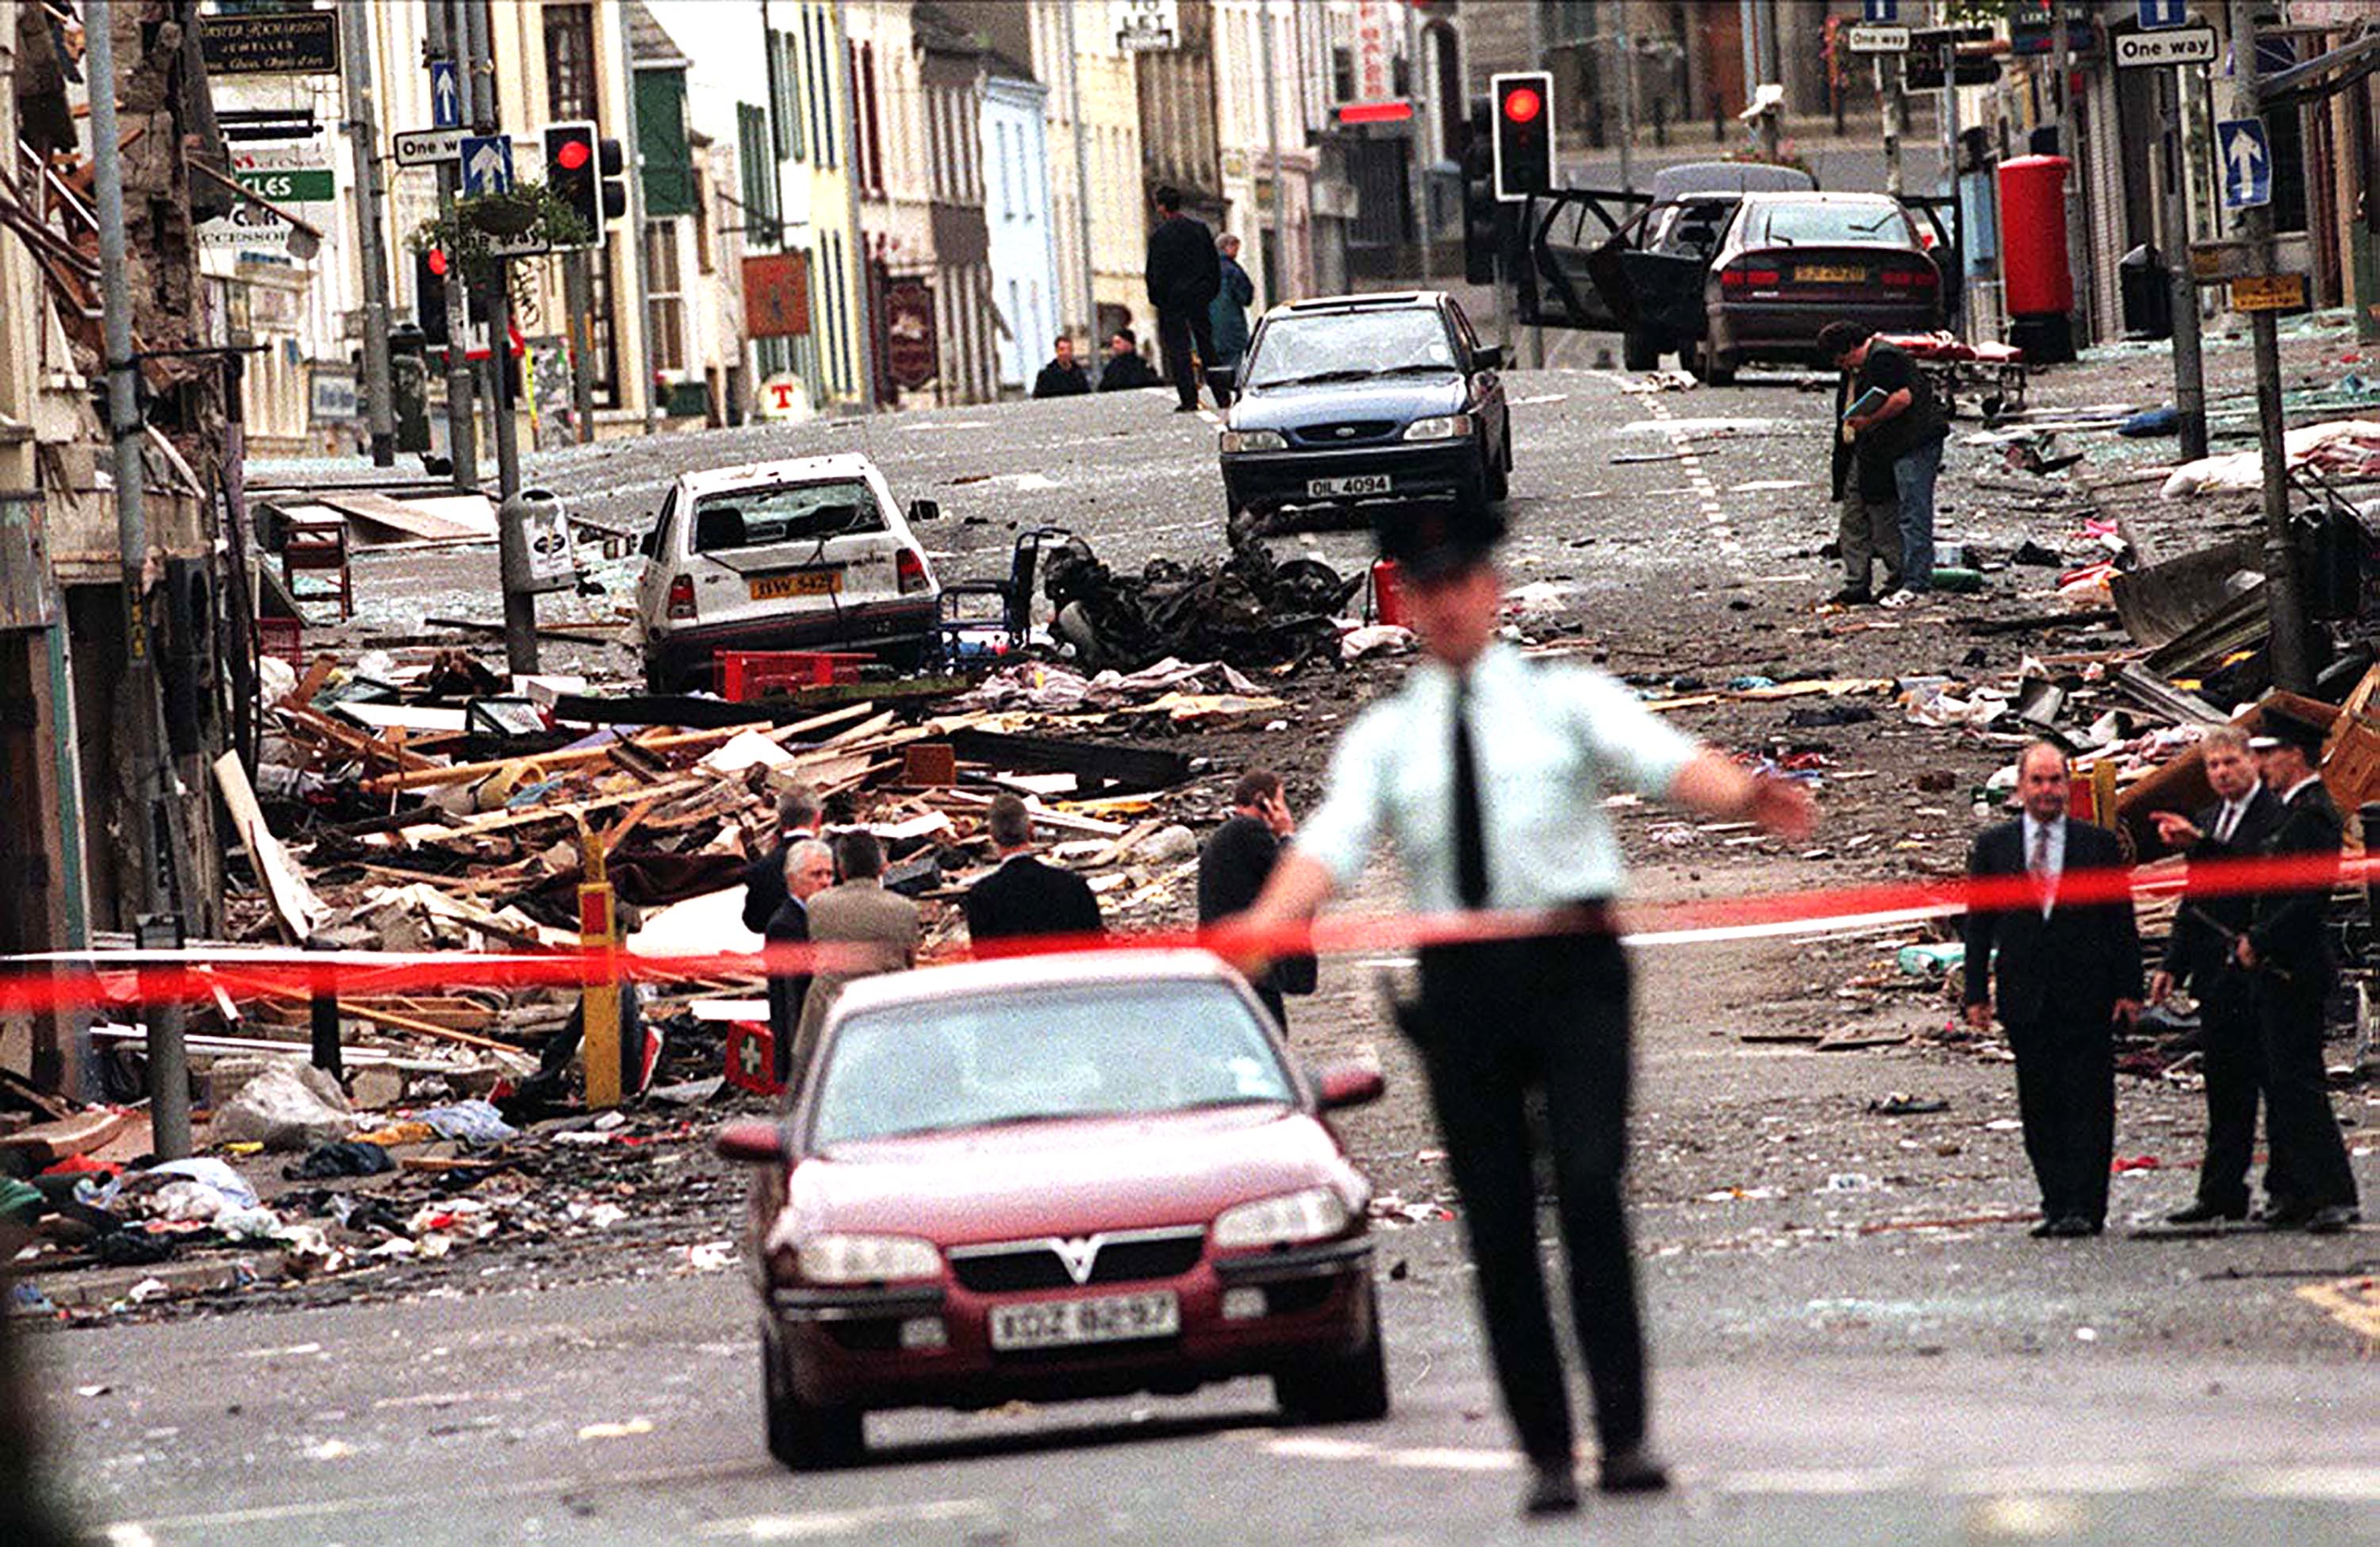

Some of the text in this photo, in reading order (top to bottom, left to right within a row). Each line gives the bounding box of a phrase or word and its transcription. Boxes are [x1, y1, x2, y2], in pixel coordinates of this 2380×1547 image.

[2122, 38, 2209, 58] One way
[403, 140, 436, 156] One
[233, 209, 278, 227] CR
[771, 384, 793, 409] T
[1311, 477, 1387, 496] OIL 4094
